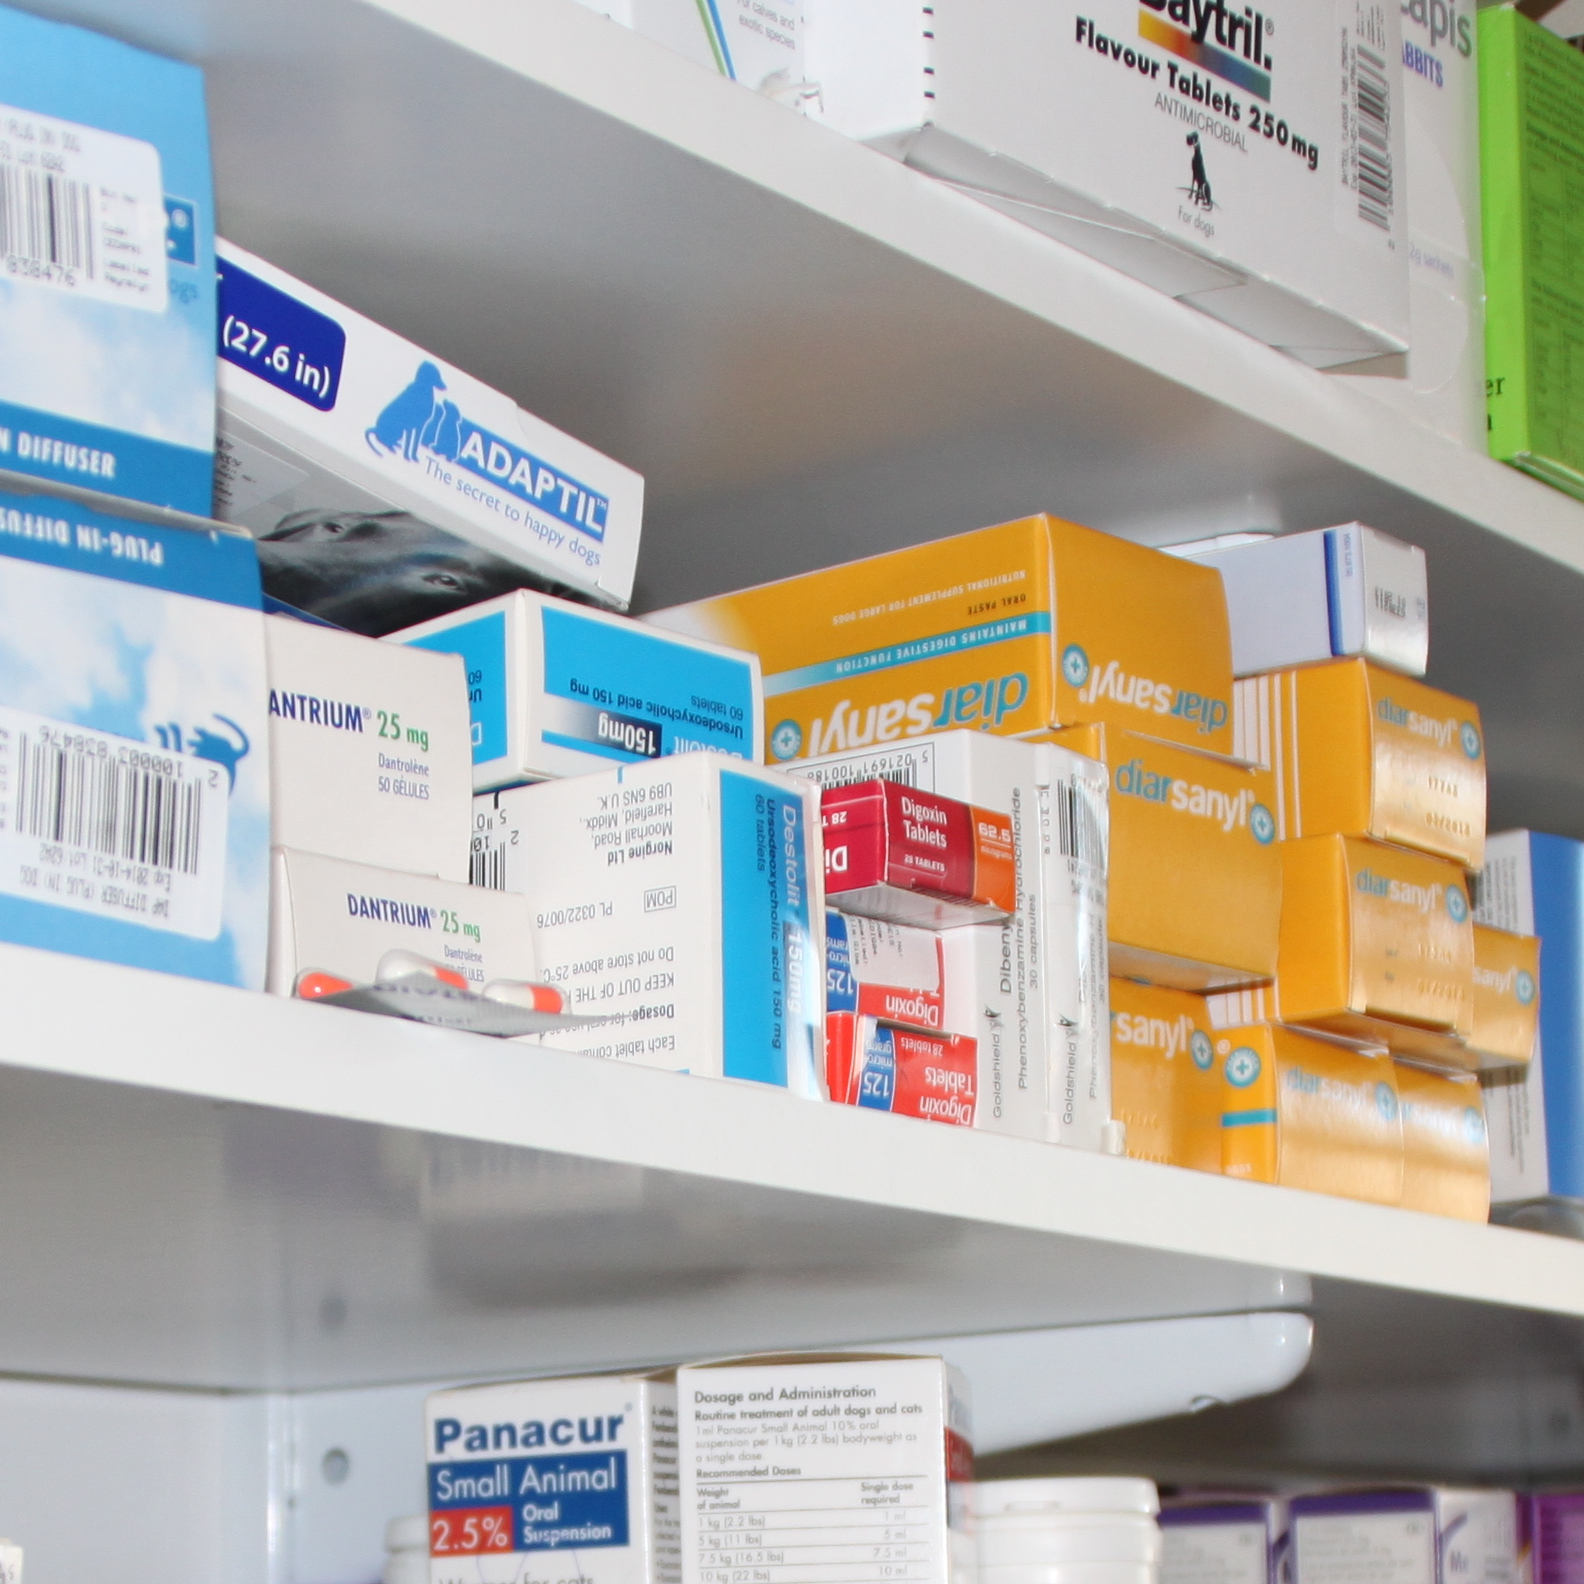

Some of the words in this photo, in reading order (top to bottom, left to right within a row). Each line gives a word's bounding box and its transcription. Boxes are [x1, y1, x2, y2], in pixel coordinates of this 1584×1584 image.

[1075, 15, 1160, 80] Flavour
[1167, 61, 1242, 122] Tablets
[1154, 92, 1248, 154] ANTIMICROBIAL
[1178, 205, 1192, 224] For
[1194, 211, 1215, 237] dogs
[222, 314, 291, 374] (27.6
[294, 352, 331, 399] in)
[17, 430, 115, 478] DIFFUSER
[461, 430, 604, 535] ADAPTIL
[424, 456, 453, 488] The
[456, 475, 502, 511] secret
[504, 500, 521, 522] to
[523, 510, 565, 550] happy
[569, 533, 602, 567] dogs
[76, 524, 164, 566] PLUG-IN
[967, 570, 1026, 592] NUTRITIONAL
[908, 584, 964, 608] SUPPLEMENT
[961, 619, 1027, 645] MAINTAINS
[896, 637, 957, 661] DIGESTIVE
[836, 652, 892, 674] FUNCTION
[569, 678, 590, 694] mg
[592, 686, 613, 703] 150
[618, 693, 644, 711] acid
[691, 694, 728, 718] tablets
[729, 708, 744, 721] 60
[808, 671, 1029, 758] diarsanyl
[268, 688, 364, 734] ANTRIUM
[376, 711, 403, 741] 25
[406, 725, 430, 754] mg
[646, 699, 744, 740] Ursodeoxycholic
[598, 712, 657, 756] 150mg
[378, 752, 430, 778] Dantrolène
[378, 776, 390, 793] 50
[392, 775, 430, 800] GÉLULES
[623, 787, 646, 806] 6NS
[649, 782, 673, 802] UB9
[900, 796, 947, 826] Digoxin
[591, 830, 623, 851] Road,
[624, 821, 673, 845] Moorhall
[902, 819, 947, 848] Tablets
[977, 822, 1012, 843] 62.5
[607, 849, 626, 867] Ltd
[628, 839, 673, 862] Norgine
[781, 804, 800, 906] Destolit
[1013, 786, 1025, 918] Hydrochloride
[346, 893, 431, 931] DANTRIUM
[598, 901, 613, 916] PL
[646, 889, 674, 909] POM
[536, 904, 597, 929] 0322/0076
[607, 954, 635, 971] store
[638, 949, 657, 965] not
[658, 946, 674, 961] Do
[572, 958, 605, 977] above
[827, 968, 853, 995] 125
[885, 994, 939, 1027] Digoxin
[1016, 921, 1028, 1090] Phenoxybenzamine
[863, 1072, 891, 1098] 125
[924, 1066, 975, 1097] Tablets
[992, 1033, 1003, 1118] Goldshield
[1063, 1041, 1076, 1126] Goldshield
[919, 1094, 972, 1127] Digoxin
[694, 1389, 744, 1406] Dosage
[748, 1388, 775, 1402] and
[778, 1385, 876, 1400] Administration
[434, 1414, 624, 1455] Panacur
[436, 1464, 510, 1501] Small
[520, 1457, 616, 1495] Animal
[522, 1501, 559, 1523] Oral
[432, 1514, 508, 1552] 2.5%
[523, 1523, 612, 1547] Suspension
